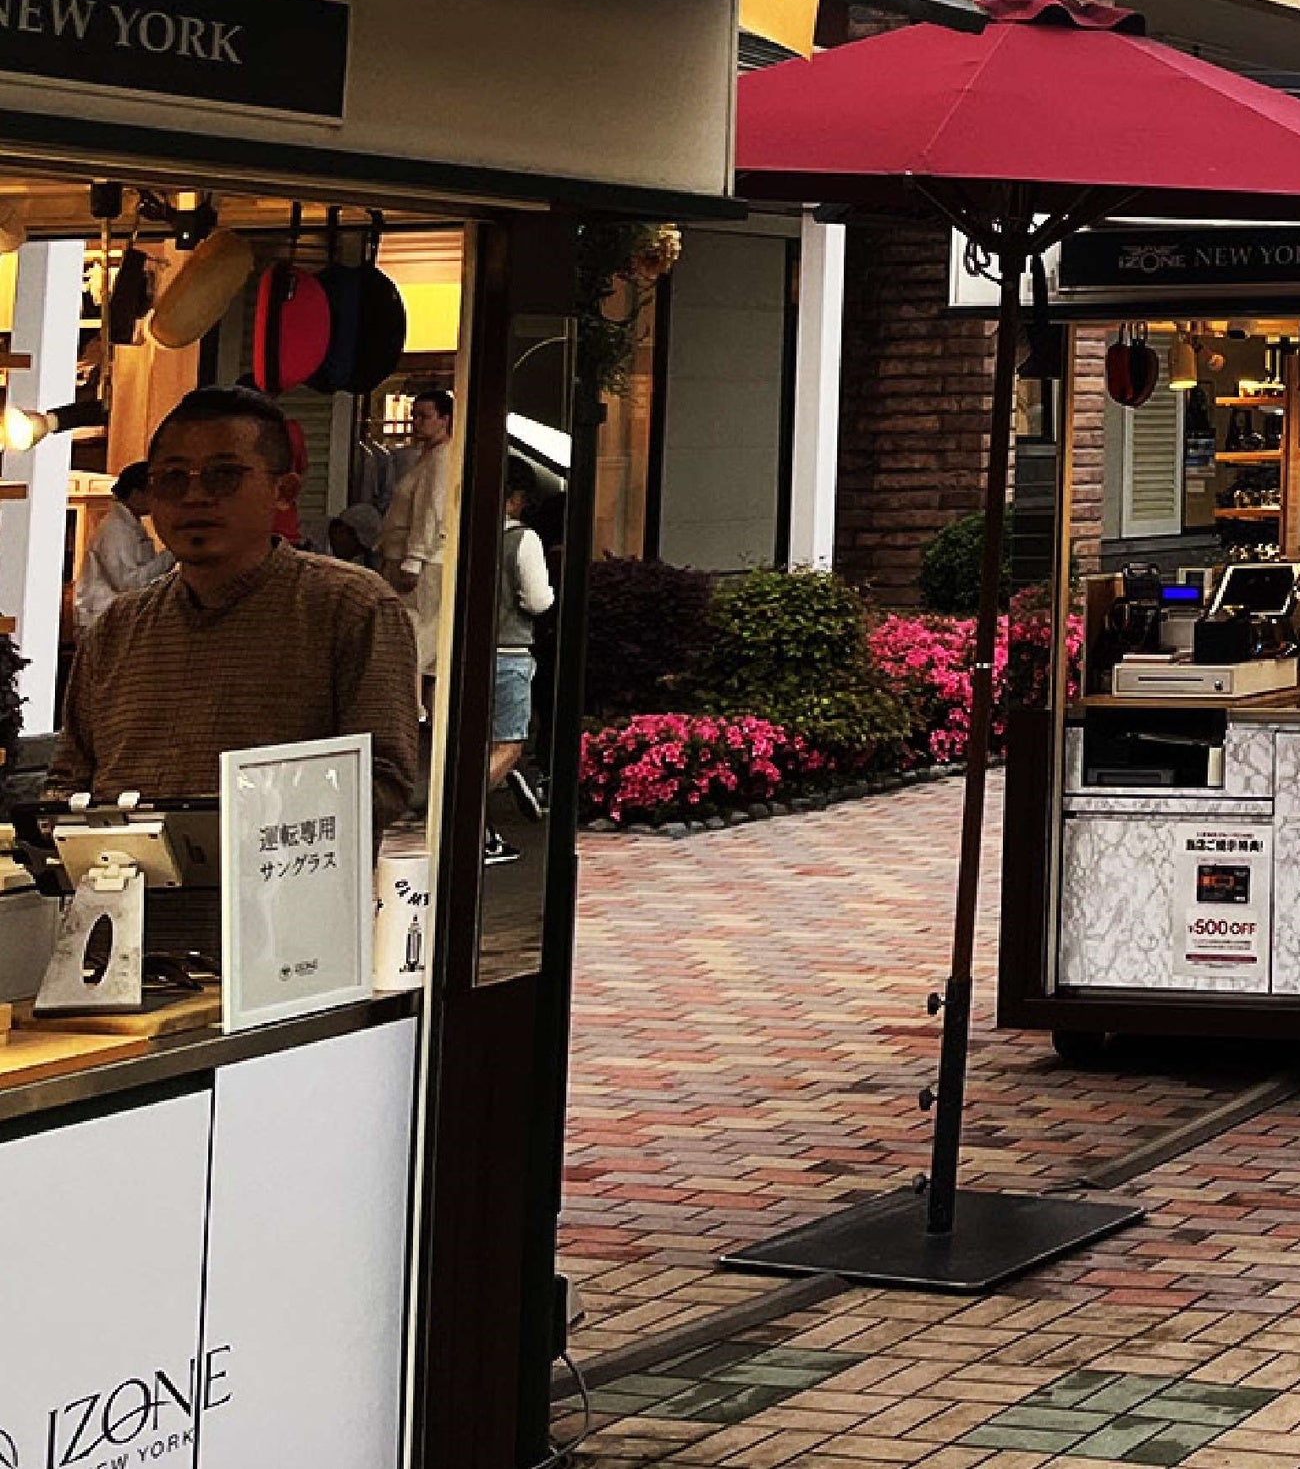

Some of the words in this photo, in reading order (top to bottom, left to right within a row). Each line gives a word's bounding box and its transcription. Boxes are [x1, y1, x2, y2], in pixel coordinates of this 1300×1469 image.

[106, 4, 245, 66] YORK
[1194, 244, 1253, 267] NEW
[259, 815, 337, 853] 運転専用
[259, 851, 338, 882] サングラス
[1229, 922, 1257, 935] OFF
[136, 1427, 195, 1464] YORK
